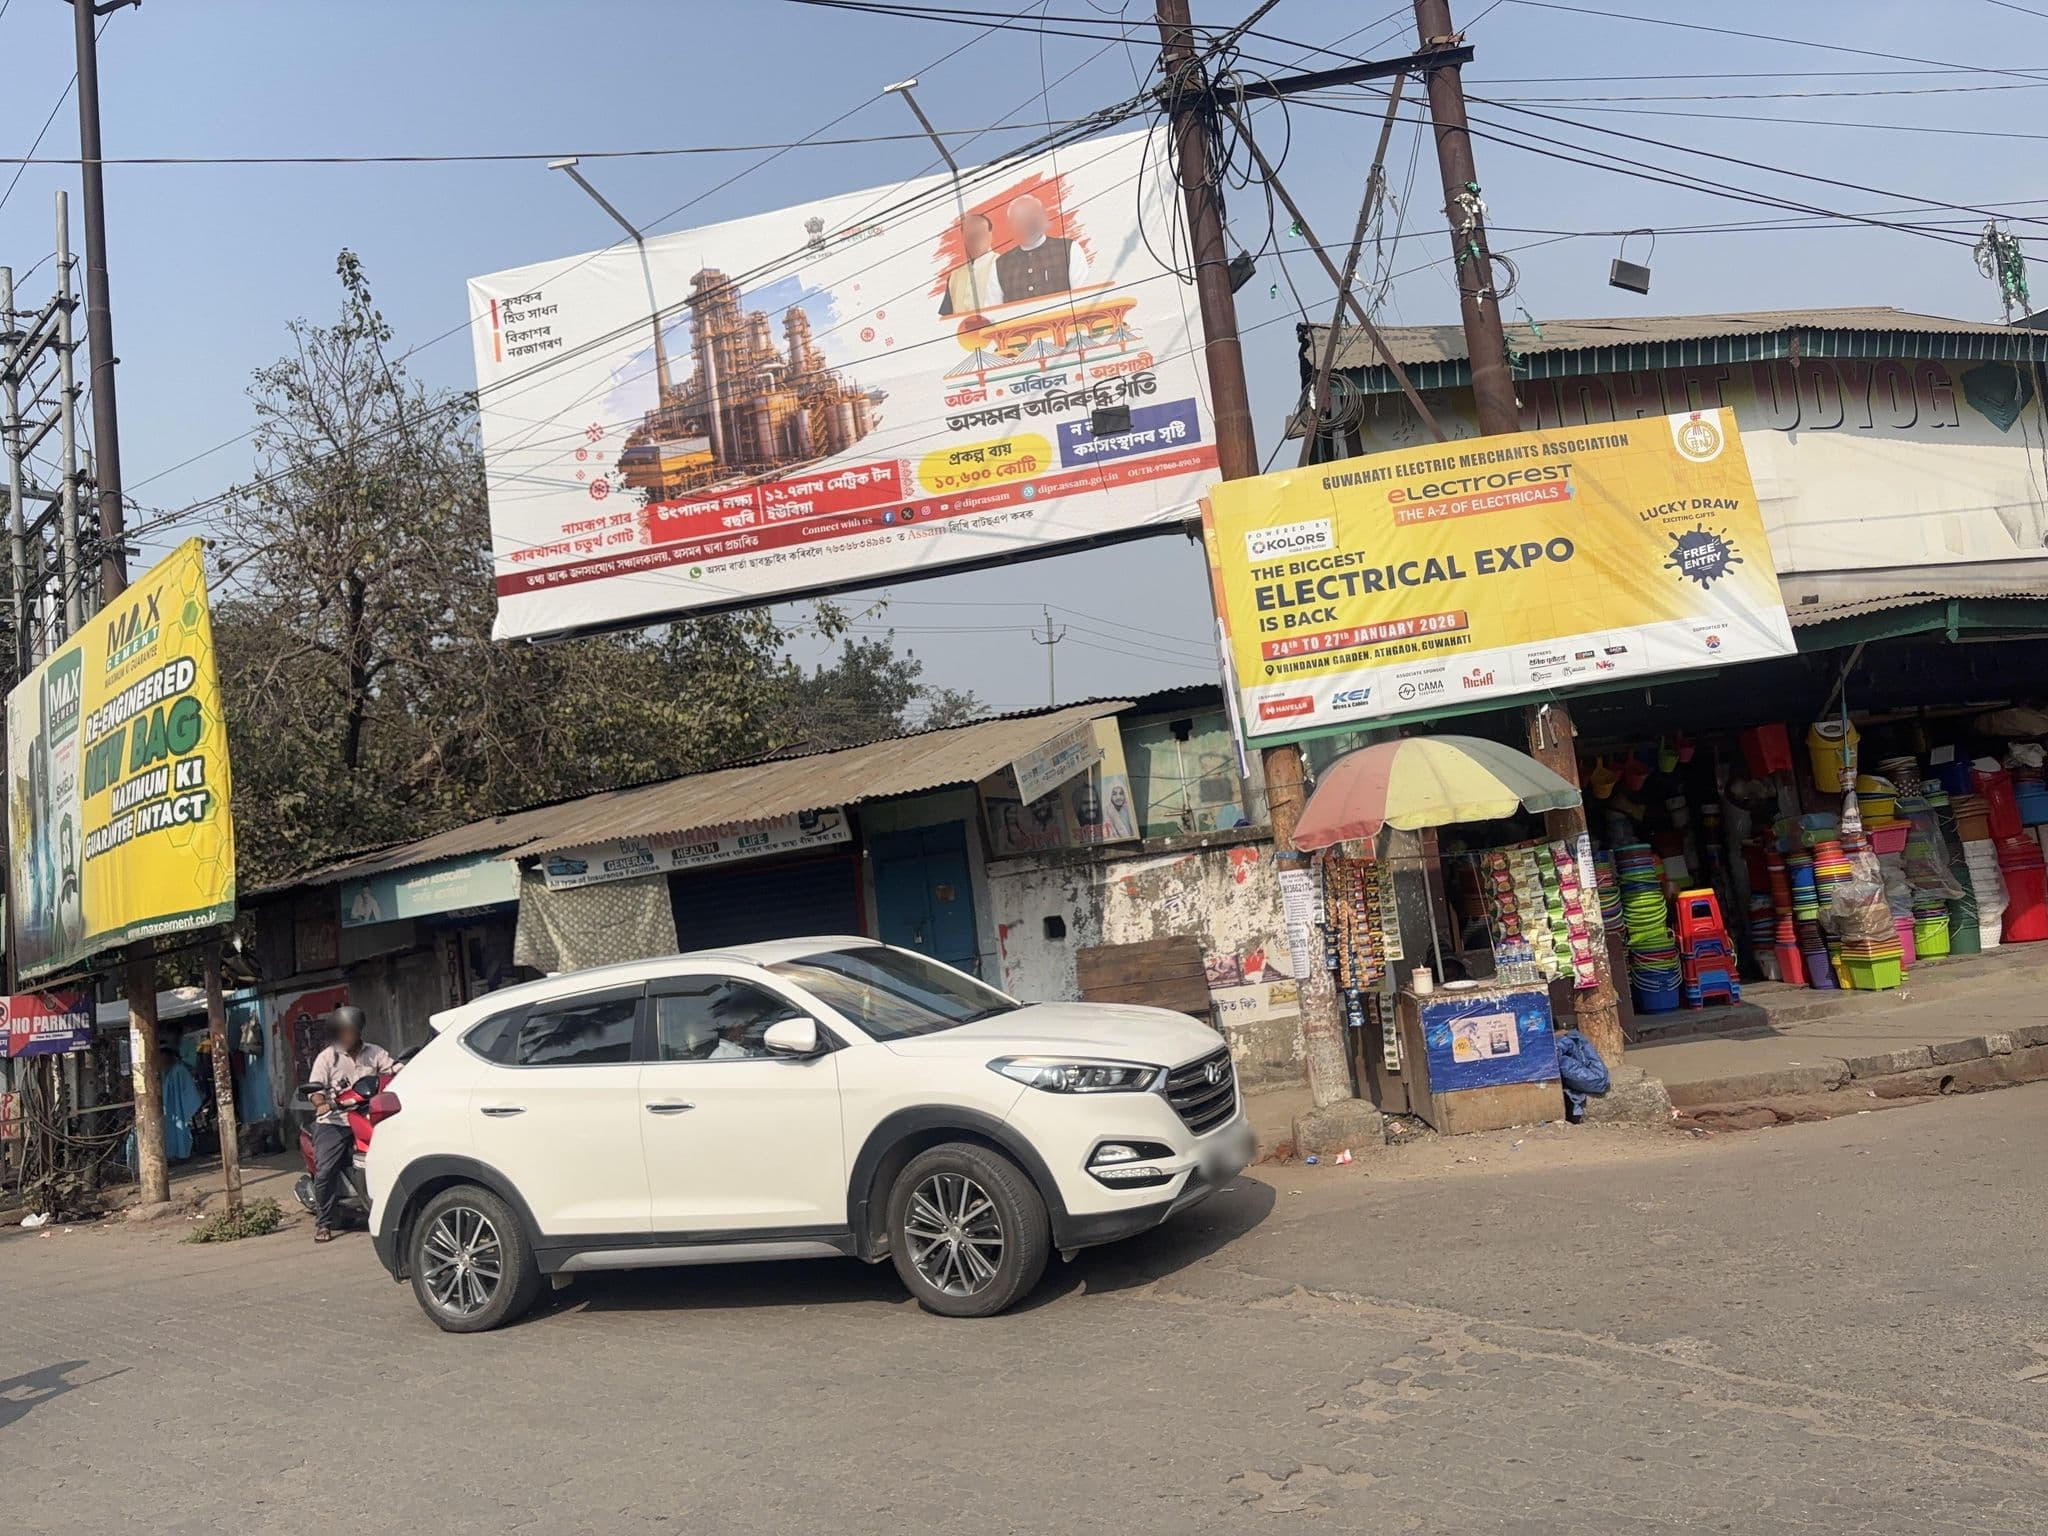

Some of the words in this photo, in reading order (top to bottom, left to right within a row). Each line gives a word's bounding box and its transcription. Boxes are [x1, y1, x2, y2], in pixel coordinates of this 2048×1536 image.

[504, 311, 525, 324] হিত
[527, 304, 558, 318] সাধন
[944, 389, 988, 407] অটল
[1009, 373, 1067, 394] অবিচল
[1754, 358, 1950, 432] UDYOG
[945, 404, 1021, 431] অসমৰ
[1158, 420, 1186, 443] সৃষ্টি
[934, 468, 991, 488] ১০,৬০০
[996, 455, 1037, 477] কোটি
[1322, 468, 1392, 490] GUWAHATI
[1396, 455, 1456, 478] ELECTRIC
[1460, 445, 1539, 469] MERCHANTS
[1542, 433, 1629, 456] ASSOCIATION
[870, 467, 891, 482] টন
[954, 492, 1010, 510] @diprassam
[1397, 507, 1424, 522] THE
[1427, 503, 1448, 517] A-Z
[1451, 500, 1469, 514] OF
[1472, 487, 1559, 511] ELECTRICALS
[1639, 500, 1687, 522] LUCKY
[1692, 498, 1739, 511] DRAW
[802, 523, 839, 536] Connect
[840, 519, 861, 529] with
[1662, 513, 1694, 524] EXCITING
[1695, 511, 1716, 520] GIFTS
[907, 525, 947, 541] Assam
[1267, 532, 1326, 551] KOLORS
[1683, 543, 1716, 559] FREE
[1684, 551, 1722, 570] ENTRY
[1251, 565, 1284, 581] THE
[1289, 551, 1366, 575] BIGGEST
[1255, 555, 1466, 612] ELECTRICAL
[1475, 537, 1575, 576] EXPO
[107, 585, 164, 657] MAX
[1260, 617, 1279, 632] IS
[1284, 607, 1338, 629] BACK
[1302, 637, 1320, 650] TO
[1325, 632, 1349, 648] 27th
[1354, 620, 1415, 643] JANUARY
[1420, 614, 1456, 632] 2026
[107, 627, 159, 670] CEMENT
[1276, 657, 1330, 674] VRINDAVAN
[1422, 634, 1472, 652] GUWAHATI
[50, 667, 80, 715] MAX
[1332, 687, 1372, 704] KEI
[1418, 680, 1444, 692] CAMA
[51, 701, 78, 727] CEMENT
[84, 659, 195, 746] RE-ENGINEERED
[1276, 702, 1308, 713] HAVELLS
[84, 727, 127, 800] NEW
[130, 696, 202, 773] BAG
[112, 767, 169, 815] MAXIMUM
[177, 758, 204, 790] KI
[86, 814, 134, 860] GUARANTEE
[136, 793, 207, 836] INTACT
[676, 842, 716, 857] HEALTH
[744, 833, 765, 846] LIFE
[607, 855, 650, 870] GENERAL
[12, 1017, 30, 1034] NO
[33, 1012, 90, 1033] PARKING
